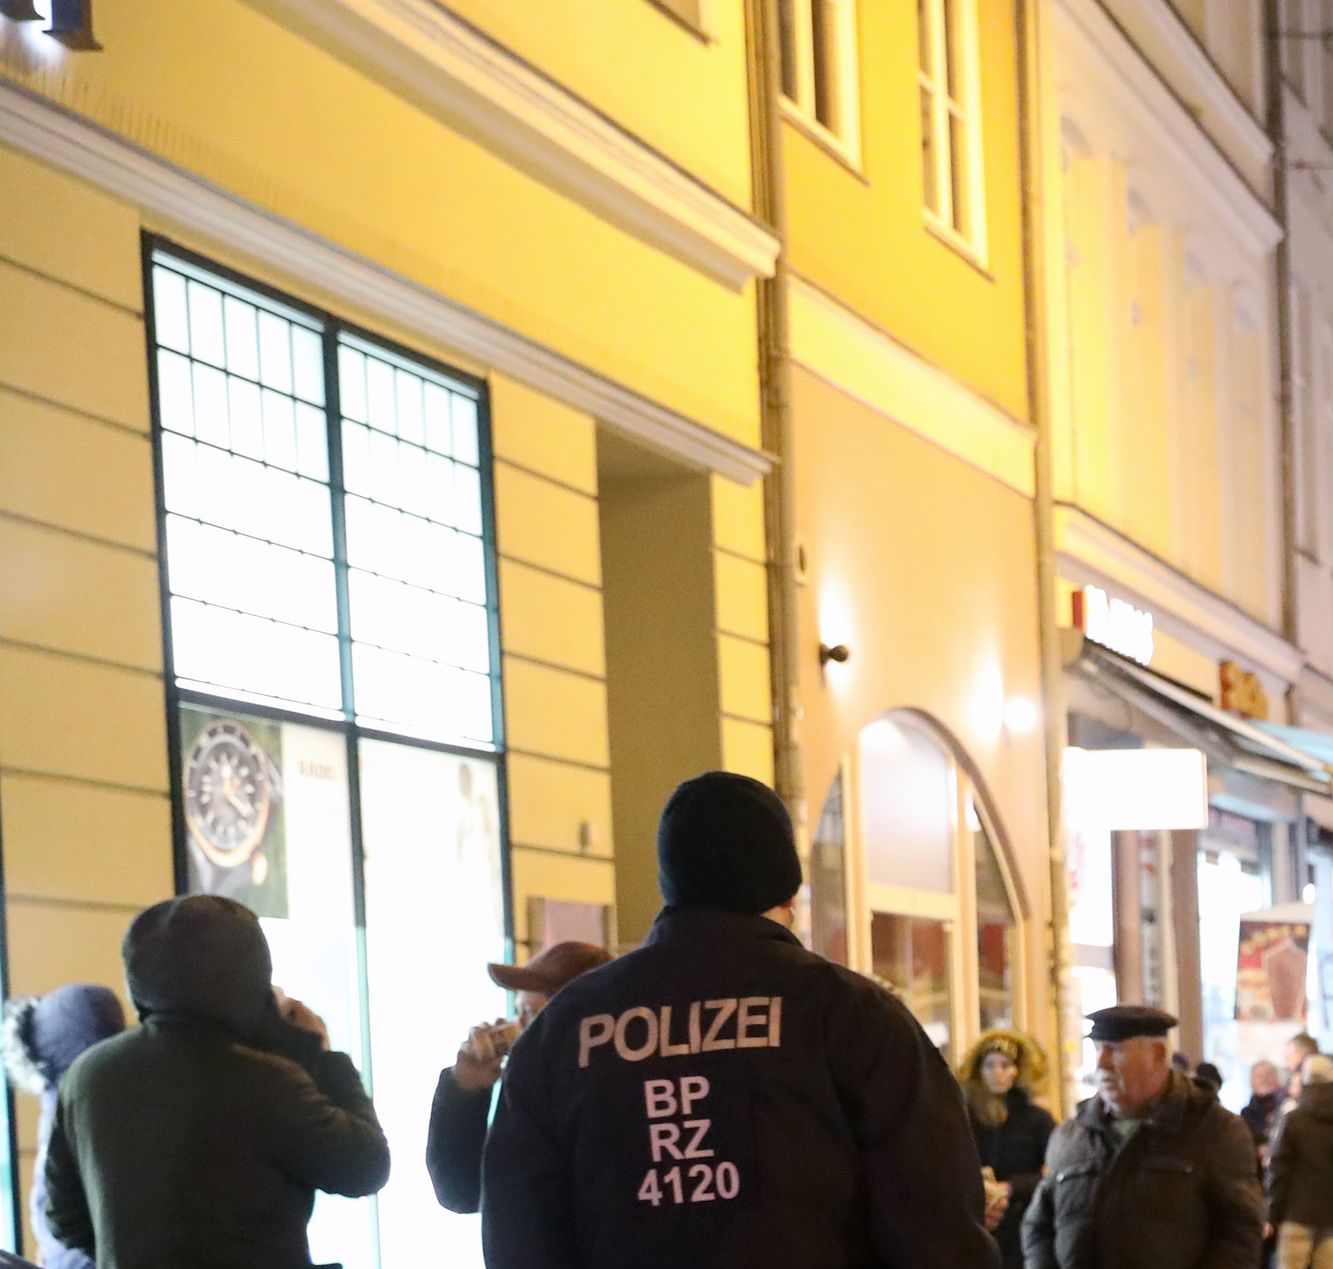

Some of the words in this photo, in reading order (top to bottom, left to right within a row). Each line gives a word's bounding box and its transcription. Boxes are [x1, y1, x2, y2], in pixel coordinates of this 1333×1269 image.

[578, 995, 782, 1069] POLIZEI
[643, 1075, 711, 1119] BP
[649, 1118, 715, 1163] RZ
[637, 1161, 741, 1207] 4120
